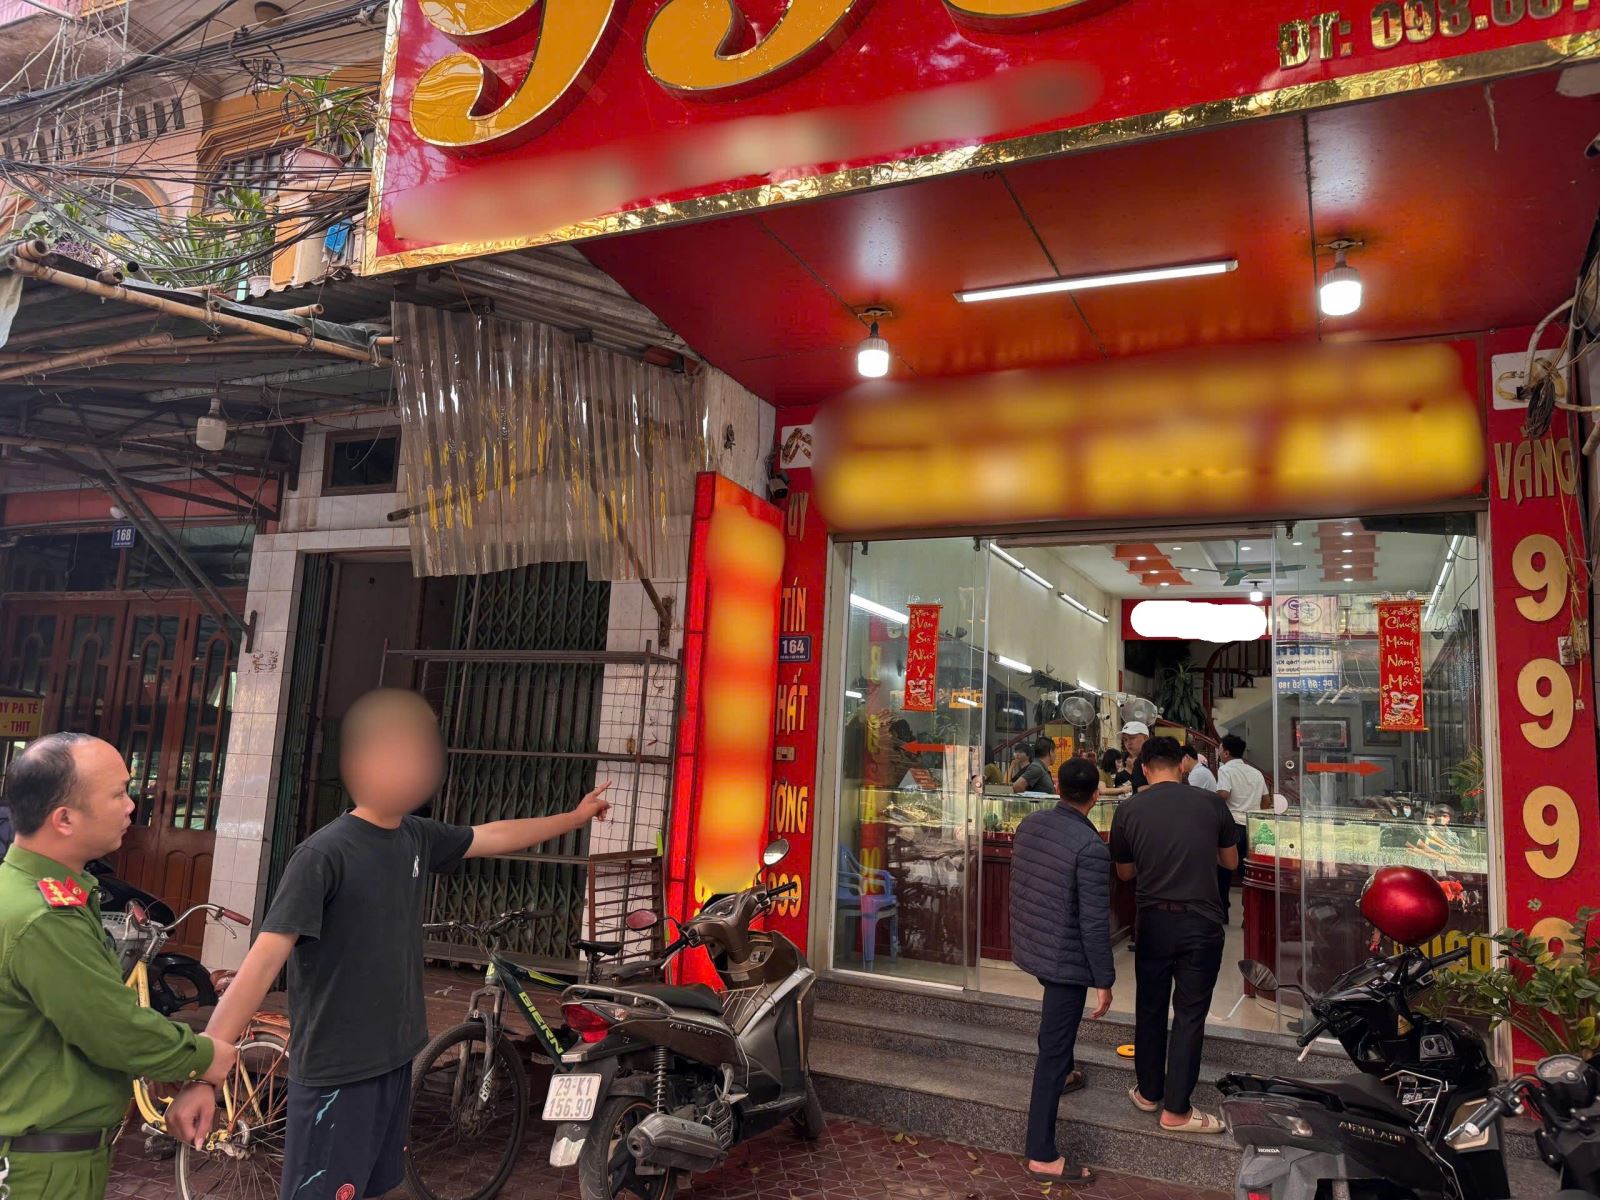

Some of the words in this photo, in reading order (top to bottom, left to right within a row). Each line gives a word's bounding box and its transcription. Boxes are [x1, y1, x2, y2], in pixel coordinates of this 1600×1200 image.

[116, 529, 132, 541] 168
[782, 576, 807, 632] TÍN
[782, 640, 804, 654] 164
[12, 702, 24, 714] PA
[776, 667, 808, 735] HẤT
[11, 720, 31, 734] THỊT
[555, 1077, 593, 1096] 29-K1
[548, 1098, 592, 1117] 156.90
